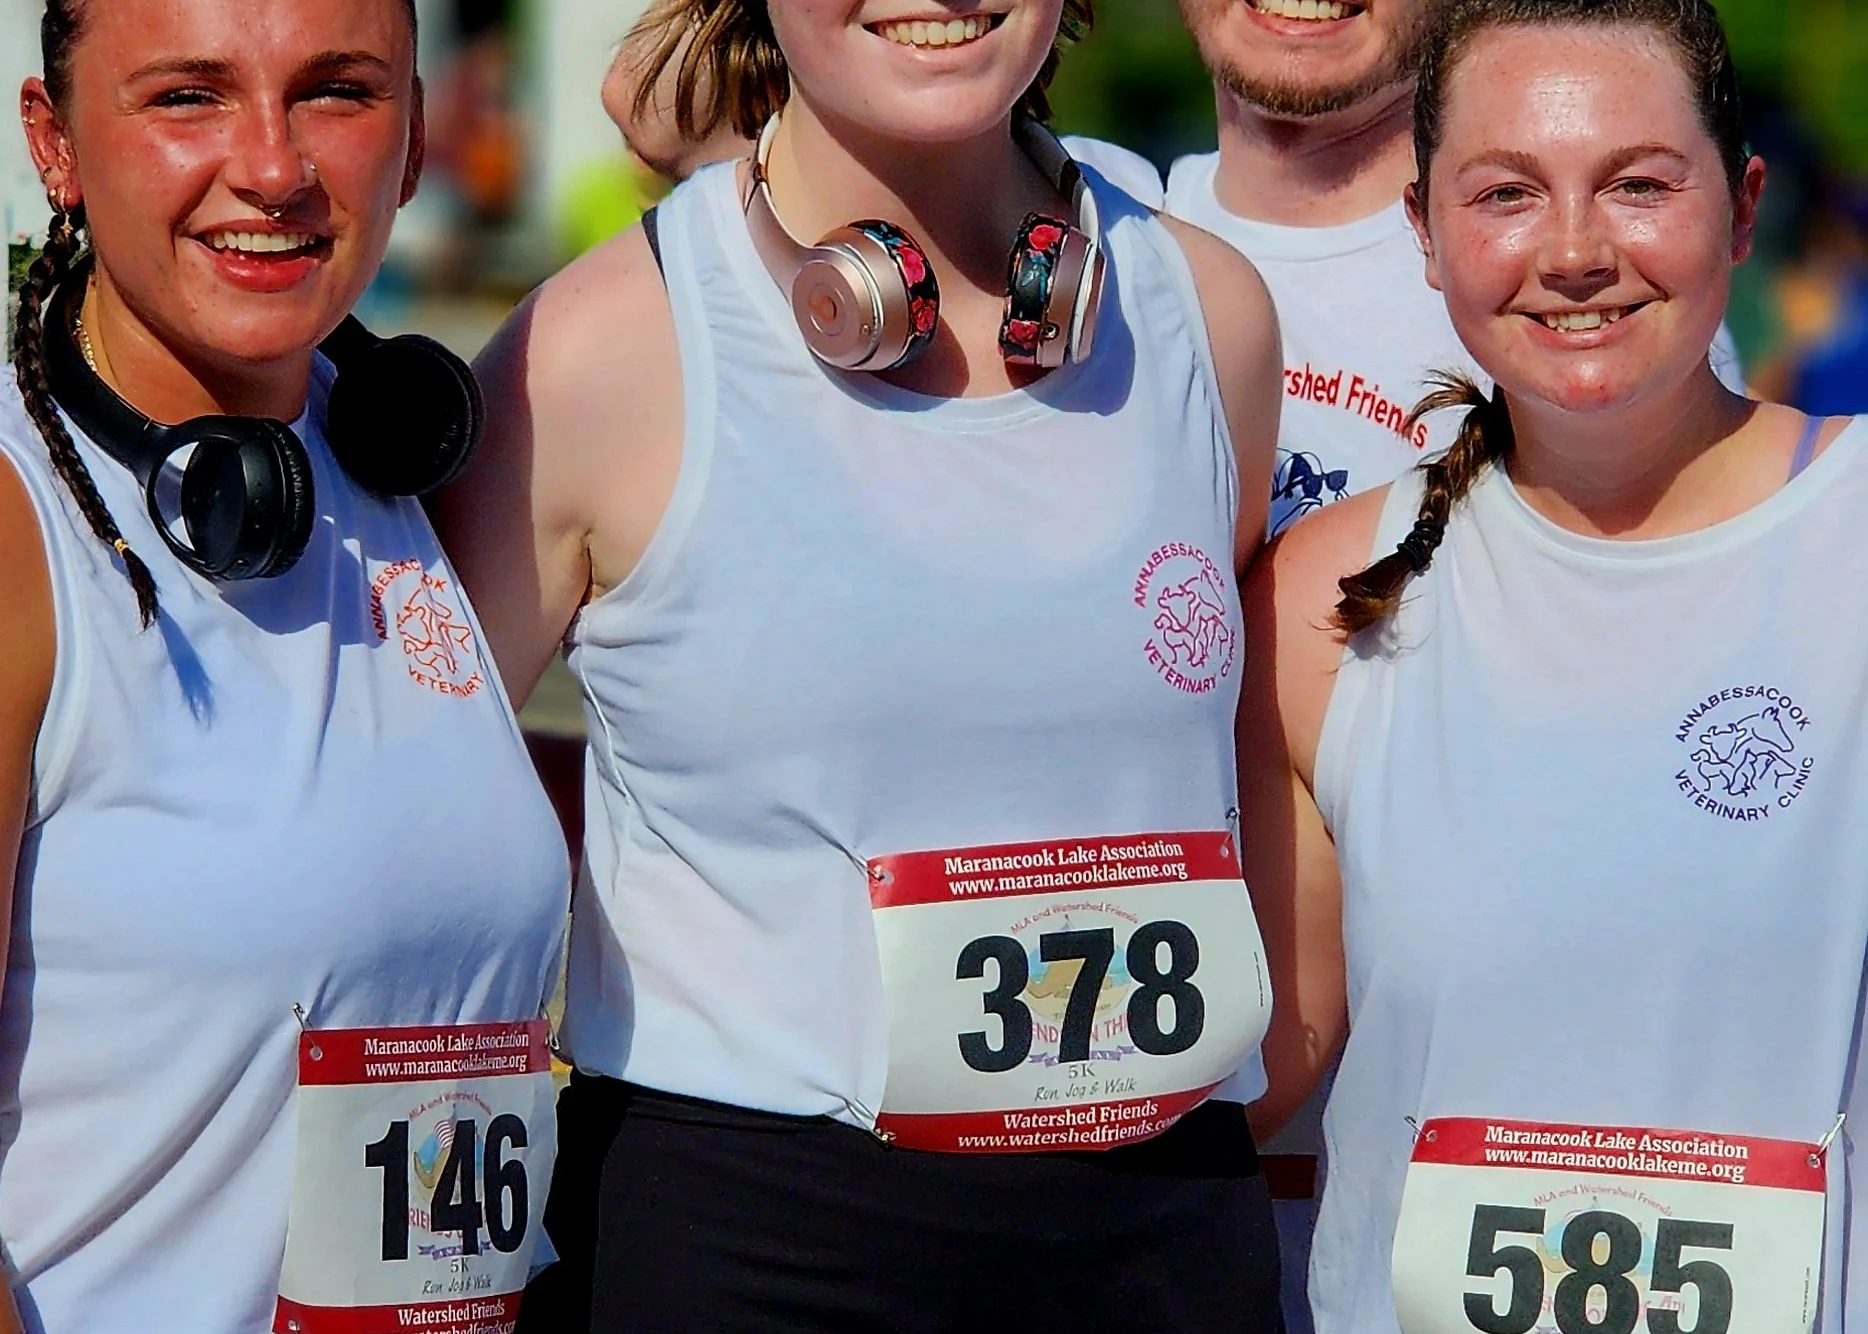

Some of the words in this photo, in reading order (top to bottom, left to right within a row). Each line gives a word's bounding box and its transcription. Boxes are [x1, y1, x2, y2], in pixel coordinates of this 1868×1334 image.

[371, 557, 446, 640] ANNABESSACOK
[1143, 638, 1217, 694] VETERINARY
[1675, 685, 1811, 743] ANNABESSACOOK
[1674, 769, 1769, 821] VETERINARY
[1778, 757, 1814, 808] CLINIC
[944, 848, 1054, 875] Maranacook
[1057, 846, 1097, 866] Lake
[1099, 840, 1184, 861] Association
[949, 862, 1188, 895] www.maranacooklakeme.org
[955, 919, 1205, 1073] 378
[364, 1034, 445, 1056] Maranacook
[447, 1033, 474, 1052] Lake
[474, 1030, 529, 1049] Association
[1065, 1083, 1086, 1099] Jog
[1104, 1077, 1138, 1095] Walk
[1003, 1107, 1096, 1129] Watershed
[1100, 1100, 1158, 1122] Friends
[1484, 1125, 1592, 1147] Maranacook
[1593, 1132, 1636, 1150] Lake
[1638, 1134, 1749, 1160] Association
[1484, 1146, 1746, 1184] www.maranacooklakeme.org
[364, 1113, 529, 1262] 146
[398, 1300, 470, 1326] Watershed
[471, 1299, 505, 1320] Friends
